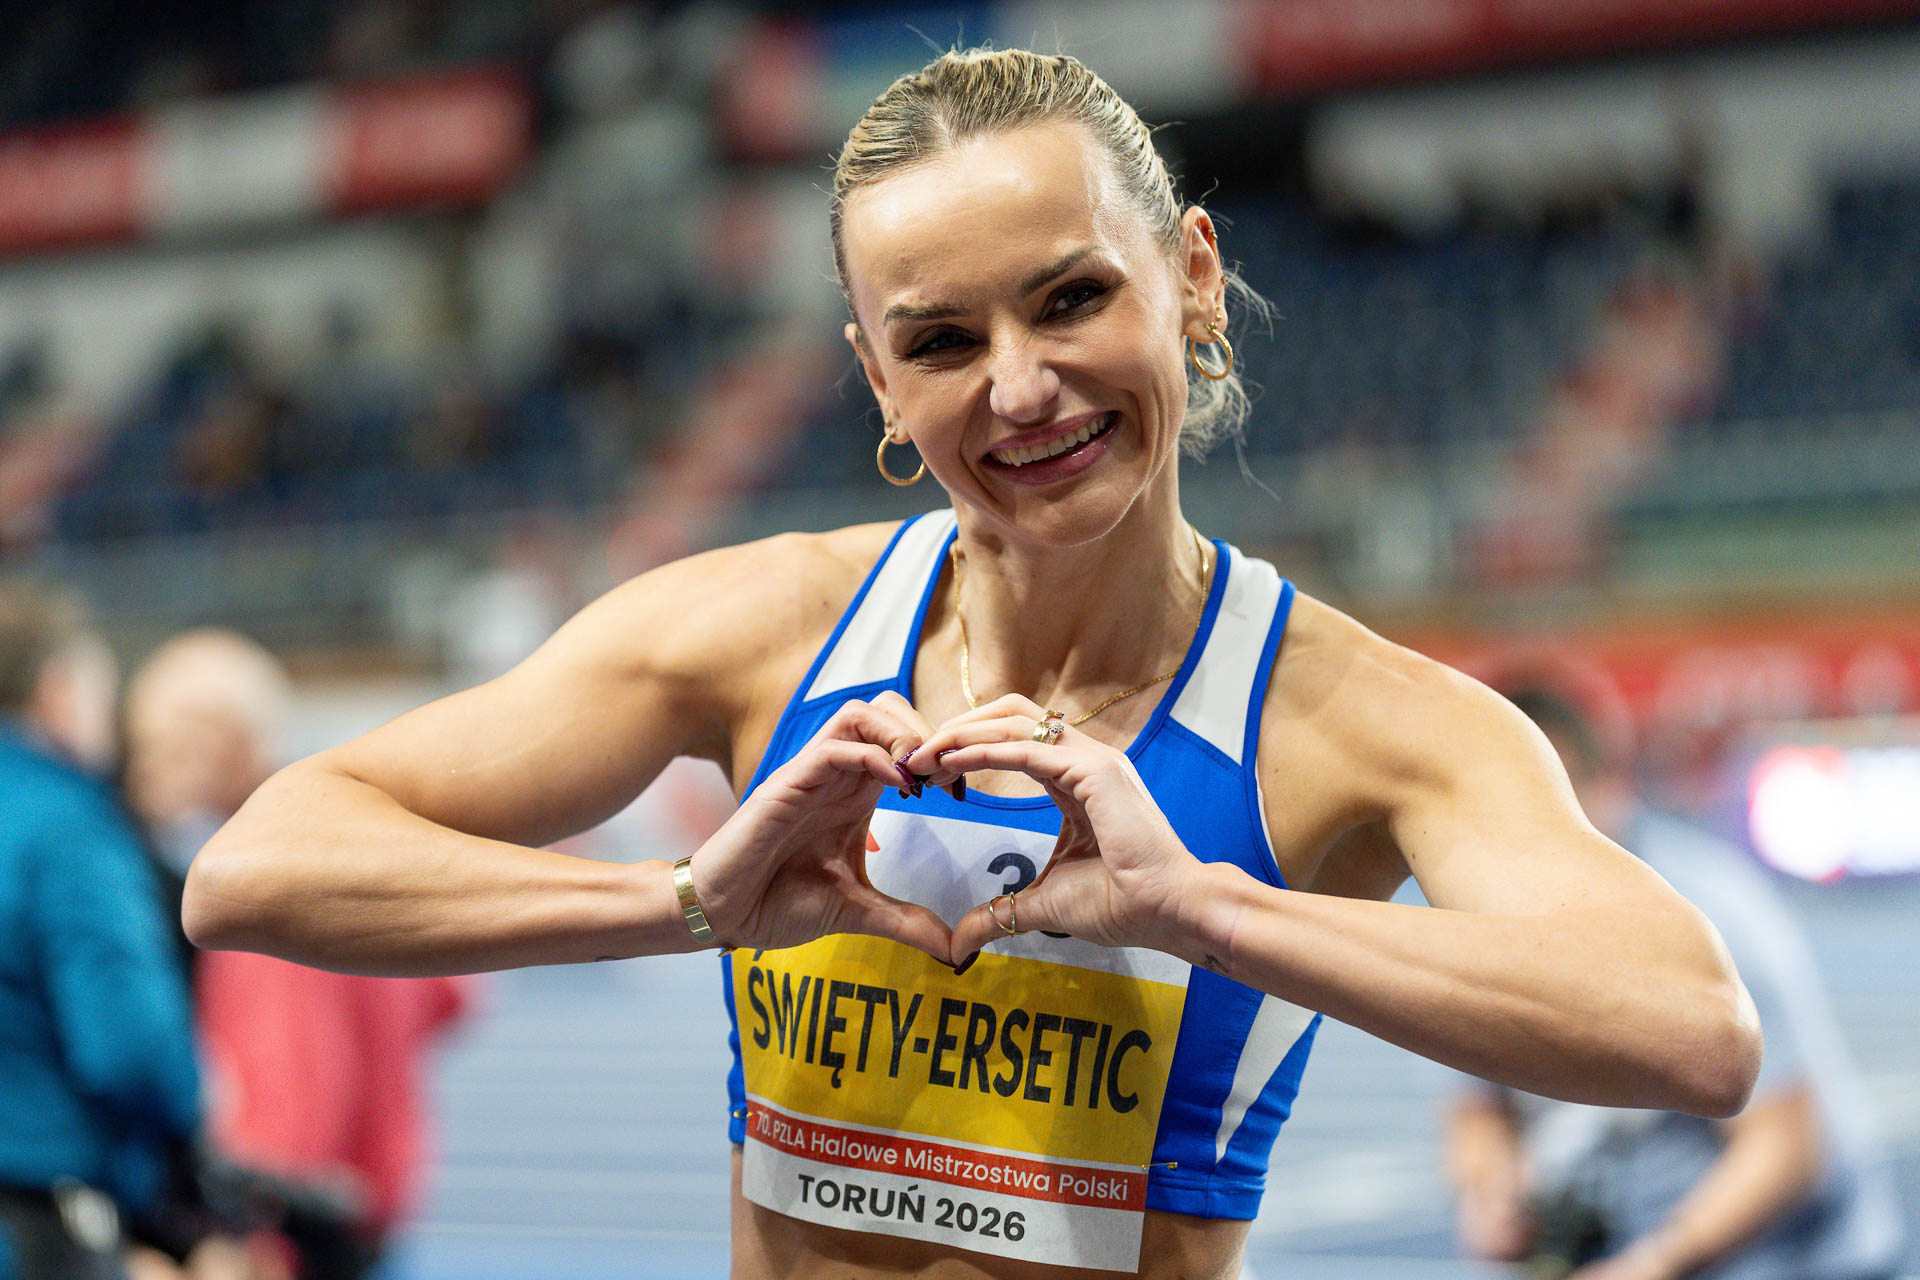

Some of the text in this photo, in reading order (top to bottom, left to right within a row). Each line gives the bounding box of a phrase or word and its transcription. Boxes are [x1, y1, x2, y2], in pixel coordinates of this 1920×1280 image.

[747, 950, 1152, 1114] ŚWIĘTY-ERSETIC
[756, 1110, 1129, 1202] 70. PZLA Halowe Mistrzostwa Polski
[798, 1173, 1026, 1242] TORUŃ 2026
